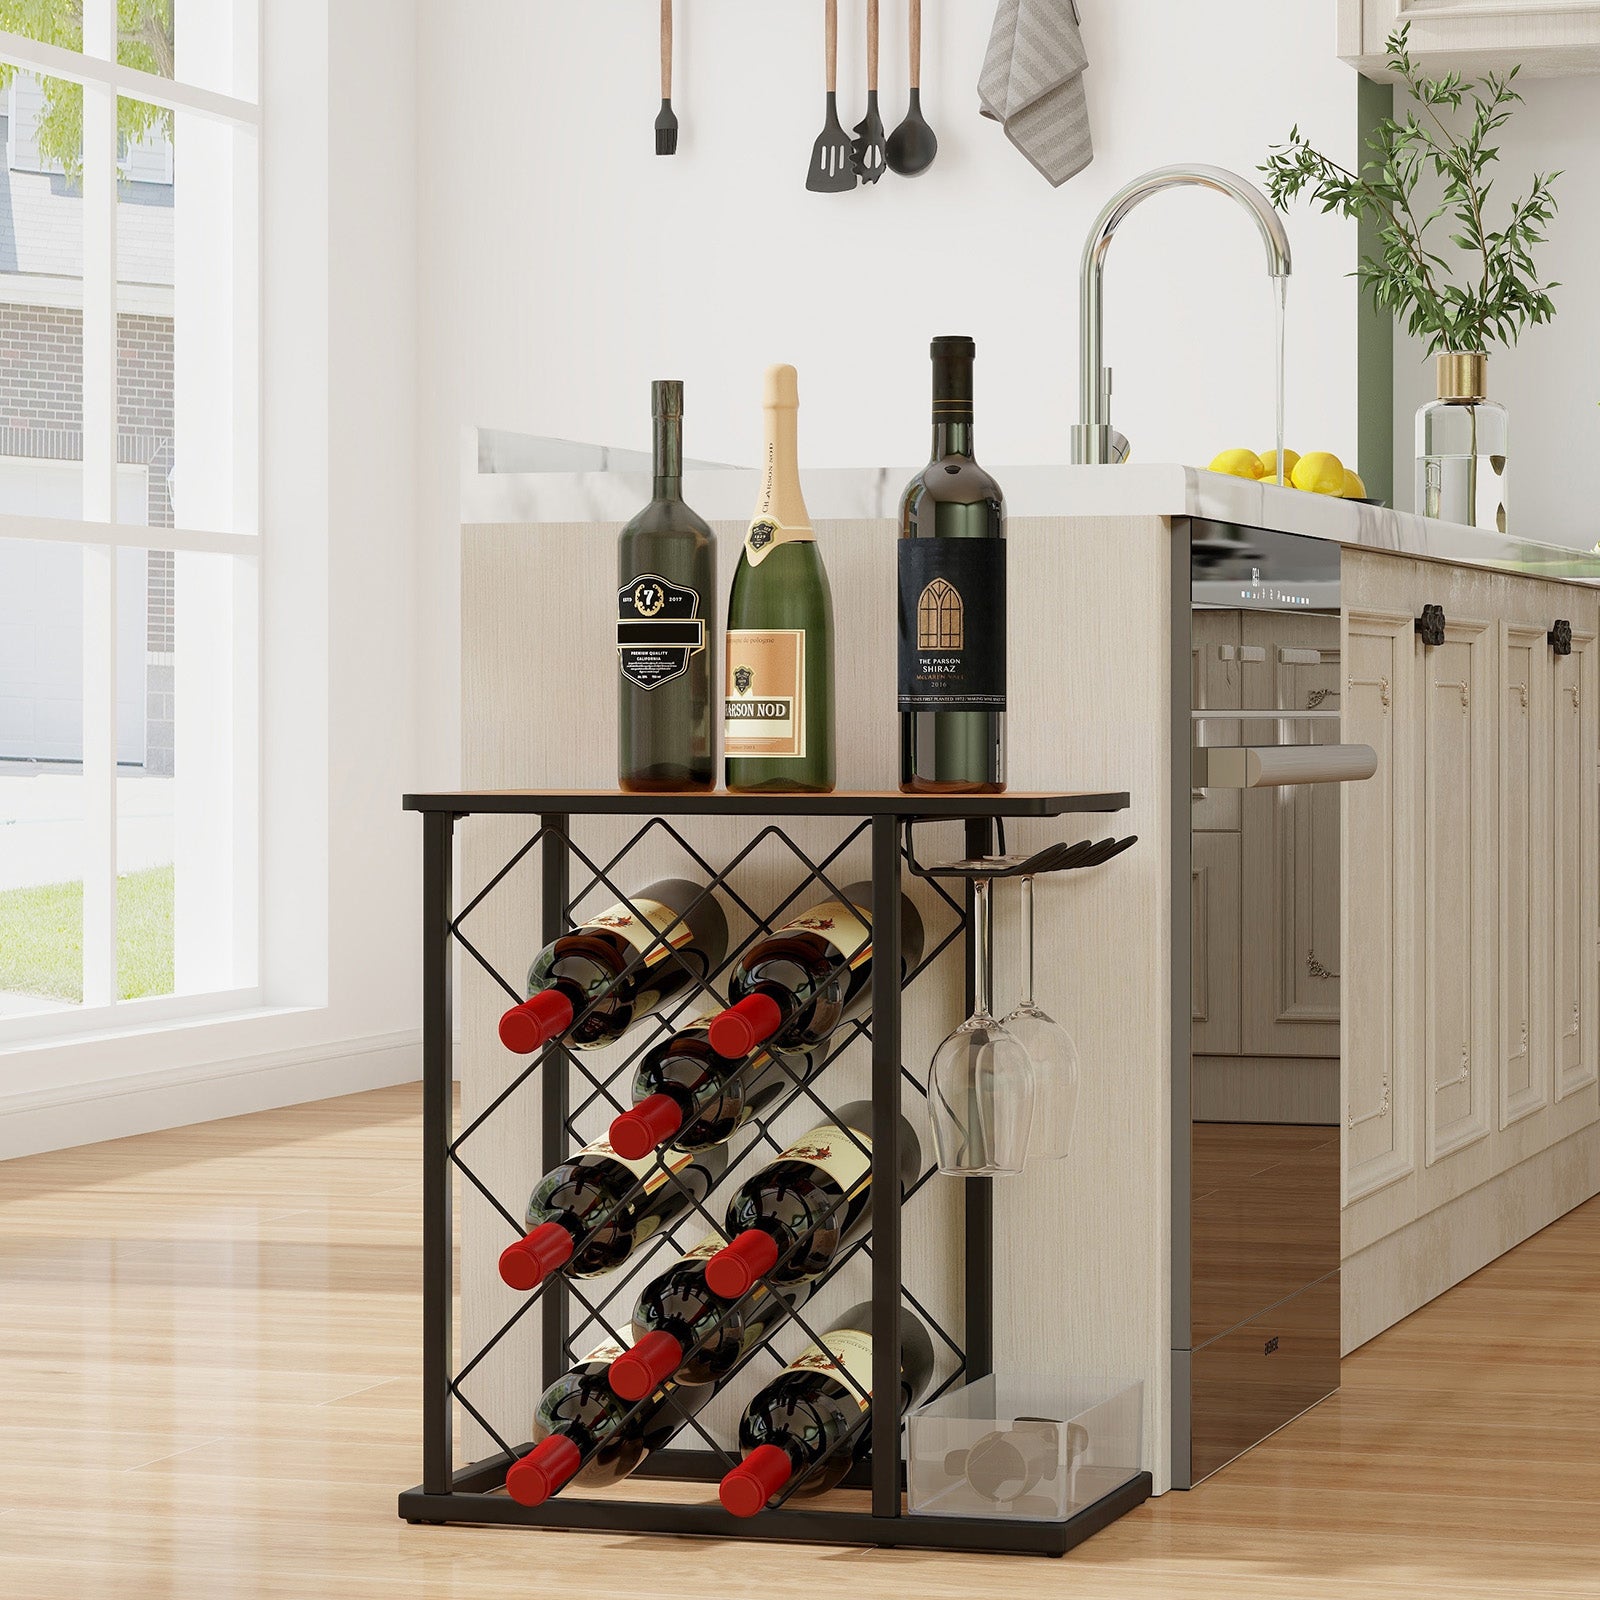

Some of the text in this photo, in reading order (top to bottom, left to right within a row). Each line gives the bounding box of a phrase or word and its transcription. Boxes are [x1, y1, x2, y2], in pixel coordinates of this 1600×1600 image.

[643, 589, 654, 606] 7
[922, 665, 956, 673] SHIRAZ
[757, 703, 786, 717] NOD
